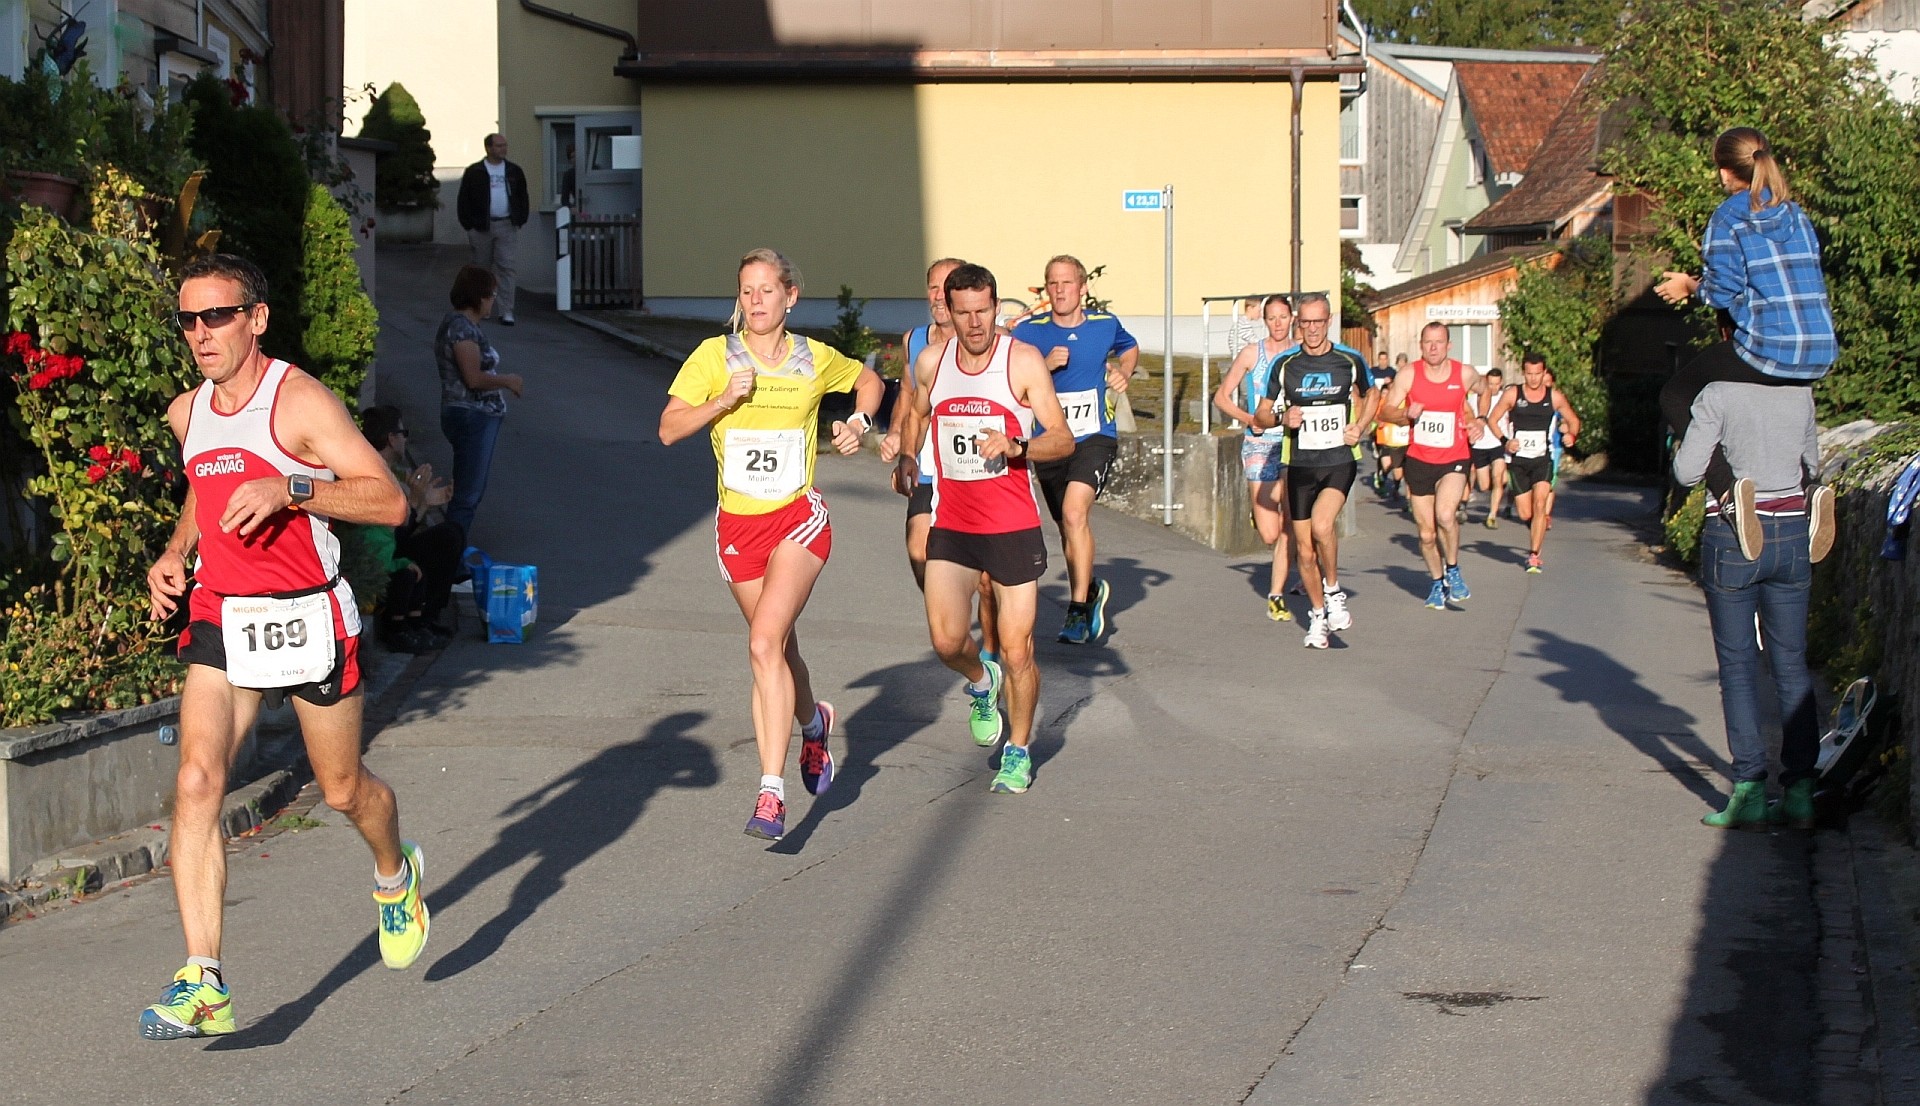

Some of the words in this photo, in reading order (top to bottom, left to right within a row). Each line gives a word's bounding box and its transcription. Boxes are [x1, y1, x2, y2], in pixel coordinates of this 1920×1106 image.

[1429, 307, 1463, 317] Elektro
[948, 403, 991, 415] GRAVAG
[1302, 418, 1339, 433] 1185
[1421, 421, 1445, 433] 180
[1524, 440, 1536, 448] 24
[746, 449, 778, 473] 25
[195, 459, 245, 478] GRAVAG
[232, 606, 269, 614] MIGROS
[242, 618, 308, 652] 169
